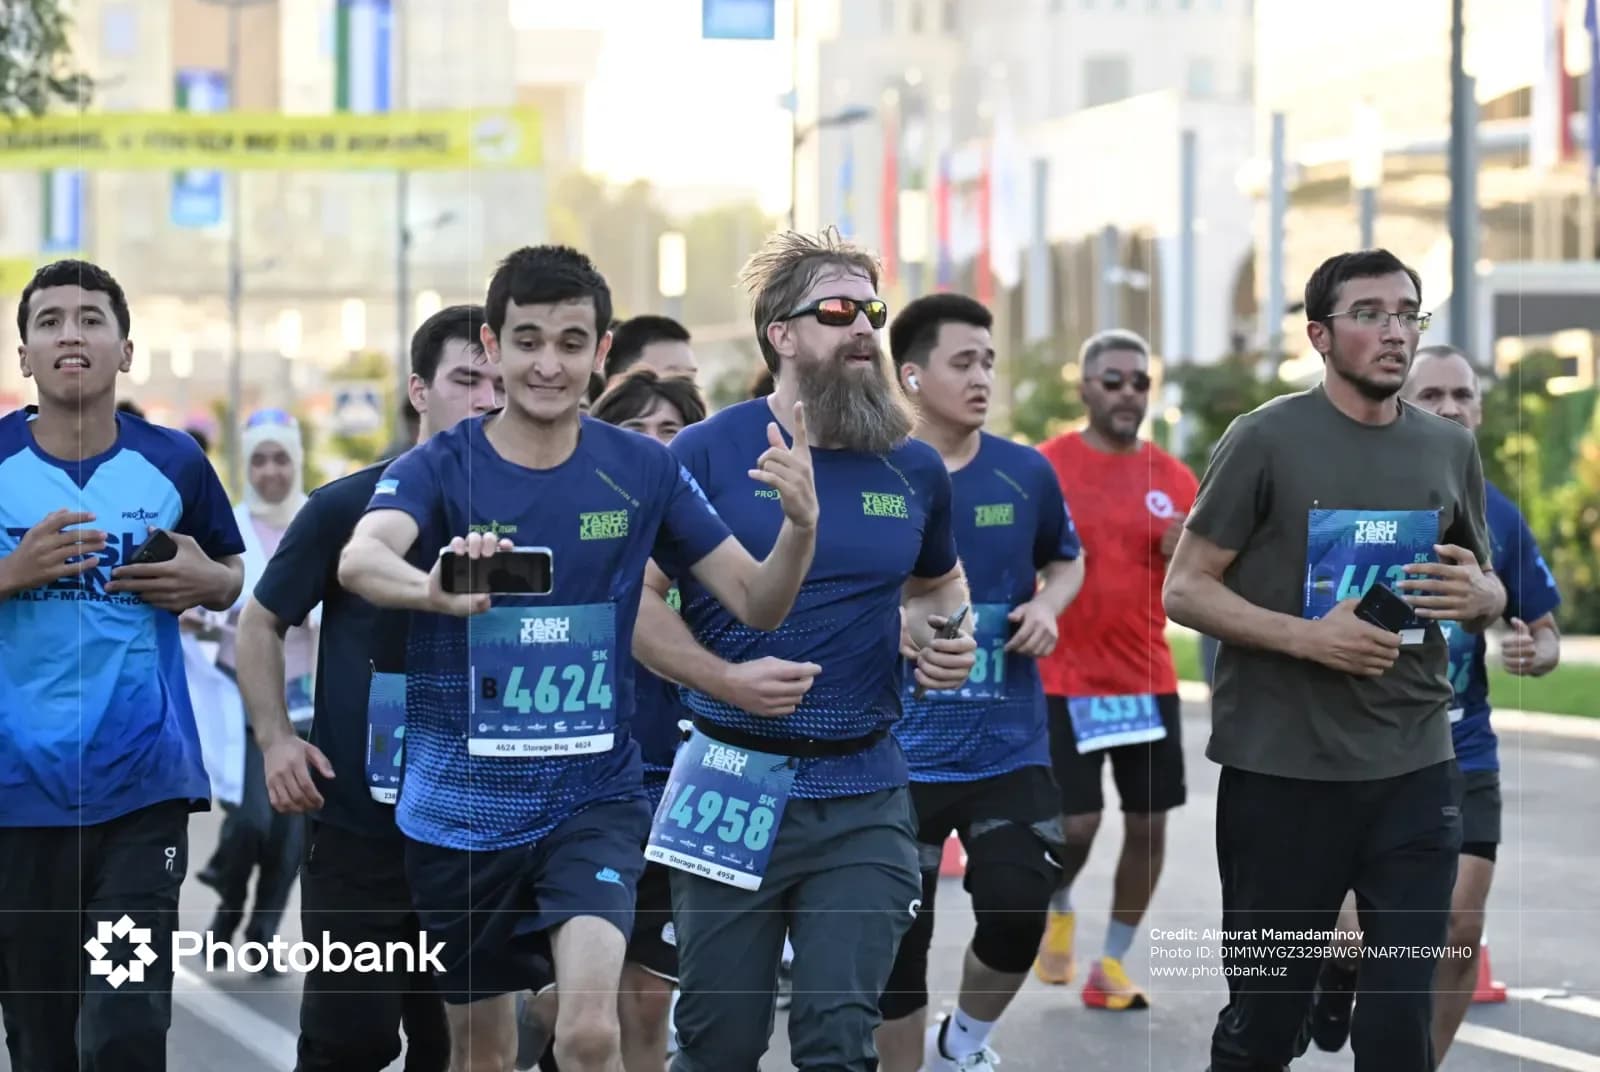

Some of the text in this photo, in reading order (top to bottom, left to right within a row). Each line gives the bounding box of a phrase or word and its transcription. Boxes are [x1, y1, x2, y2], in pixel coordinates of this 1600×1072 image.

[1355, 521, 1398, 532] TASH
[1355, 530, 1396, 541] KENT
[1414, 553, 1428, 562] 5K
[520, 617, 570, 630] TASH
[520, 628, 569, 640] KENT
[591, 650, 608, 661] 5K
[968, 647, 1005, 683] 81
[482, 677, 497, 699] B
[503, 662, 613, 714] 4624
[522, 743, 552, 752] Storage
[554, 743, 569, 751] Bag
[703, 752, 742, 773] KENT
[707, 744, 749, 767] TASH
[759, 794, 778, 809] 5K
[669, 784, 774, 851] 4958
[669, 855, 697, 869] Storage
[697, 863, 711, 875] Bag
[716, 870, 735, 881] 4958
